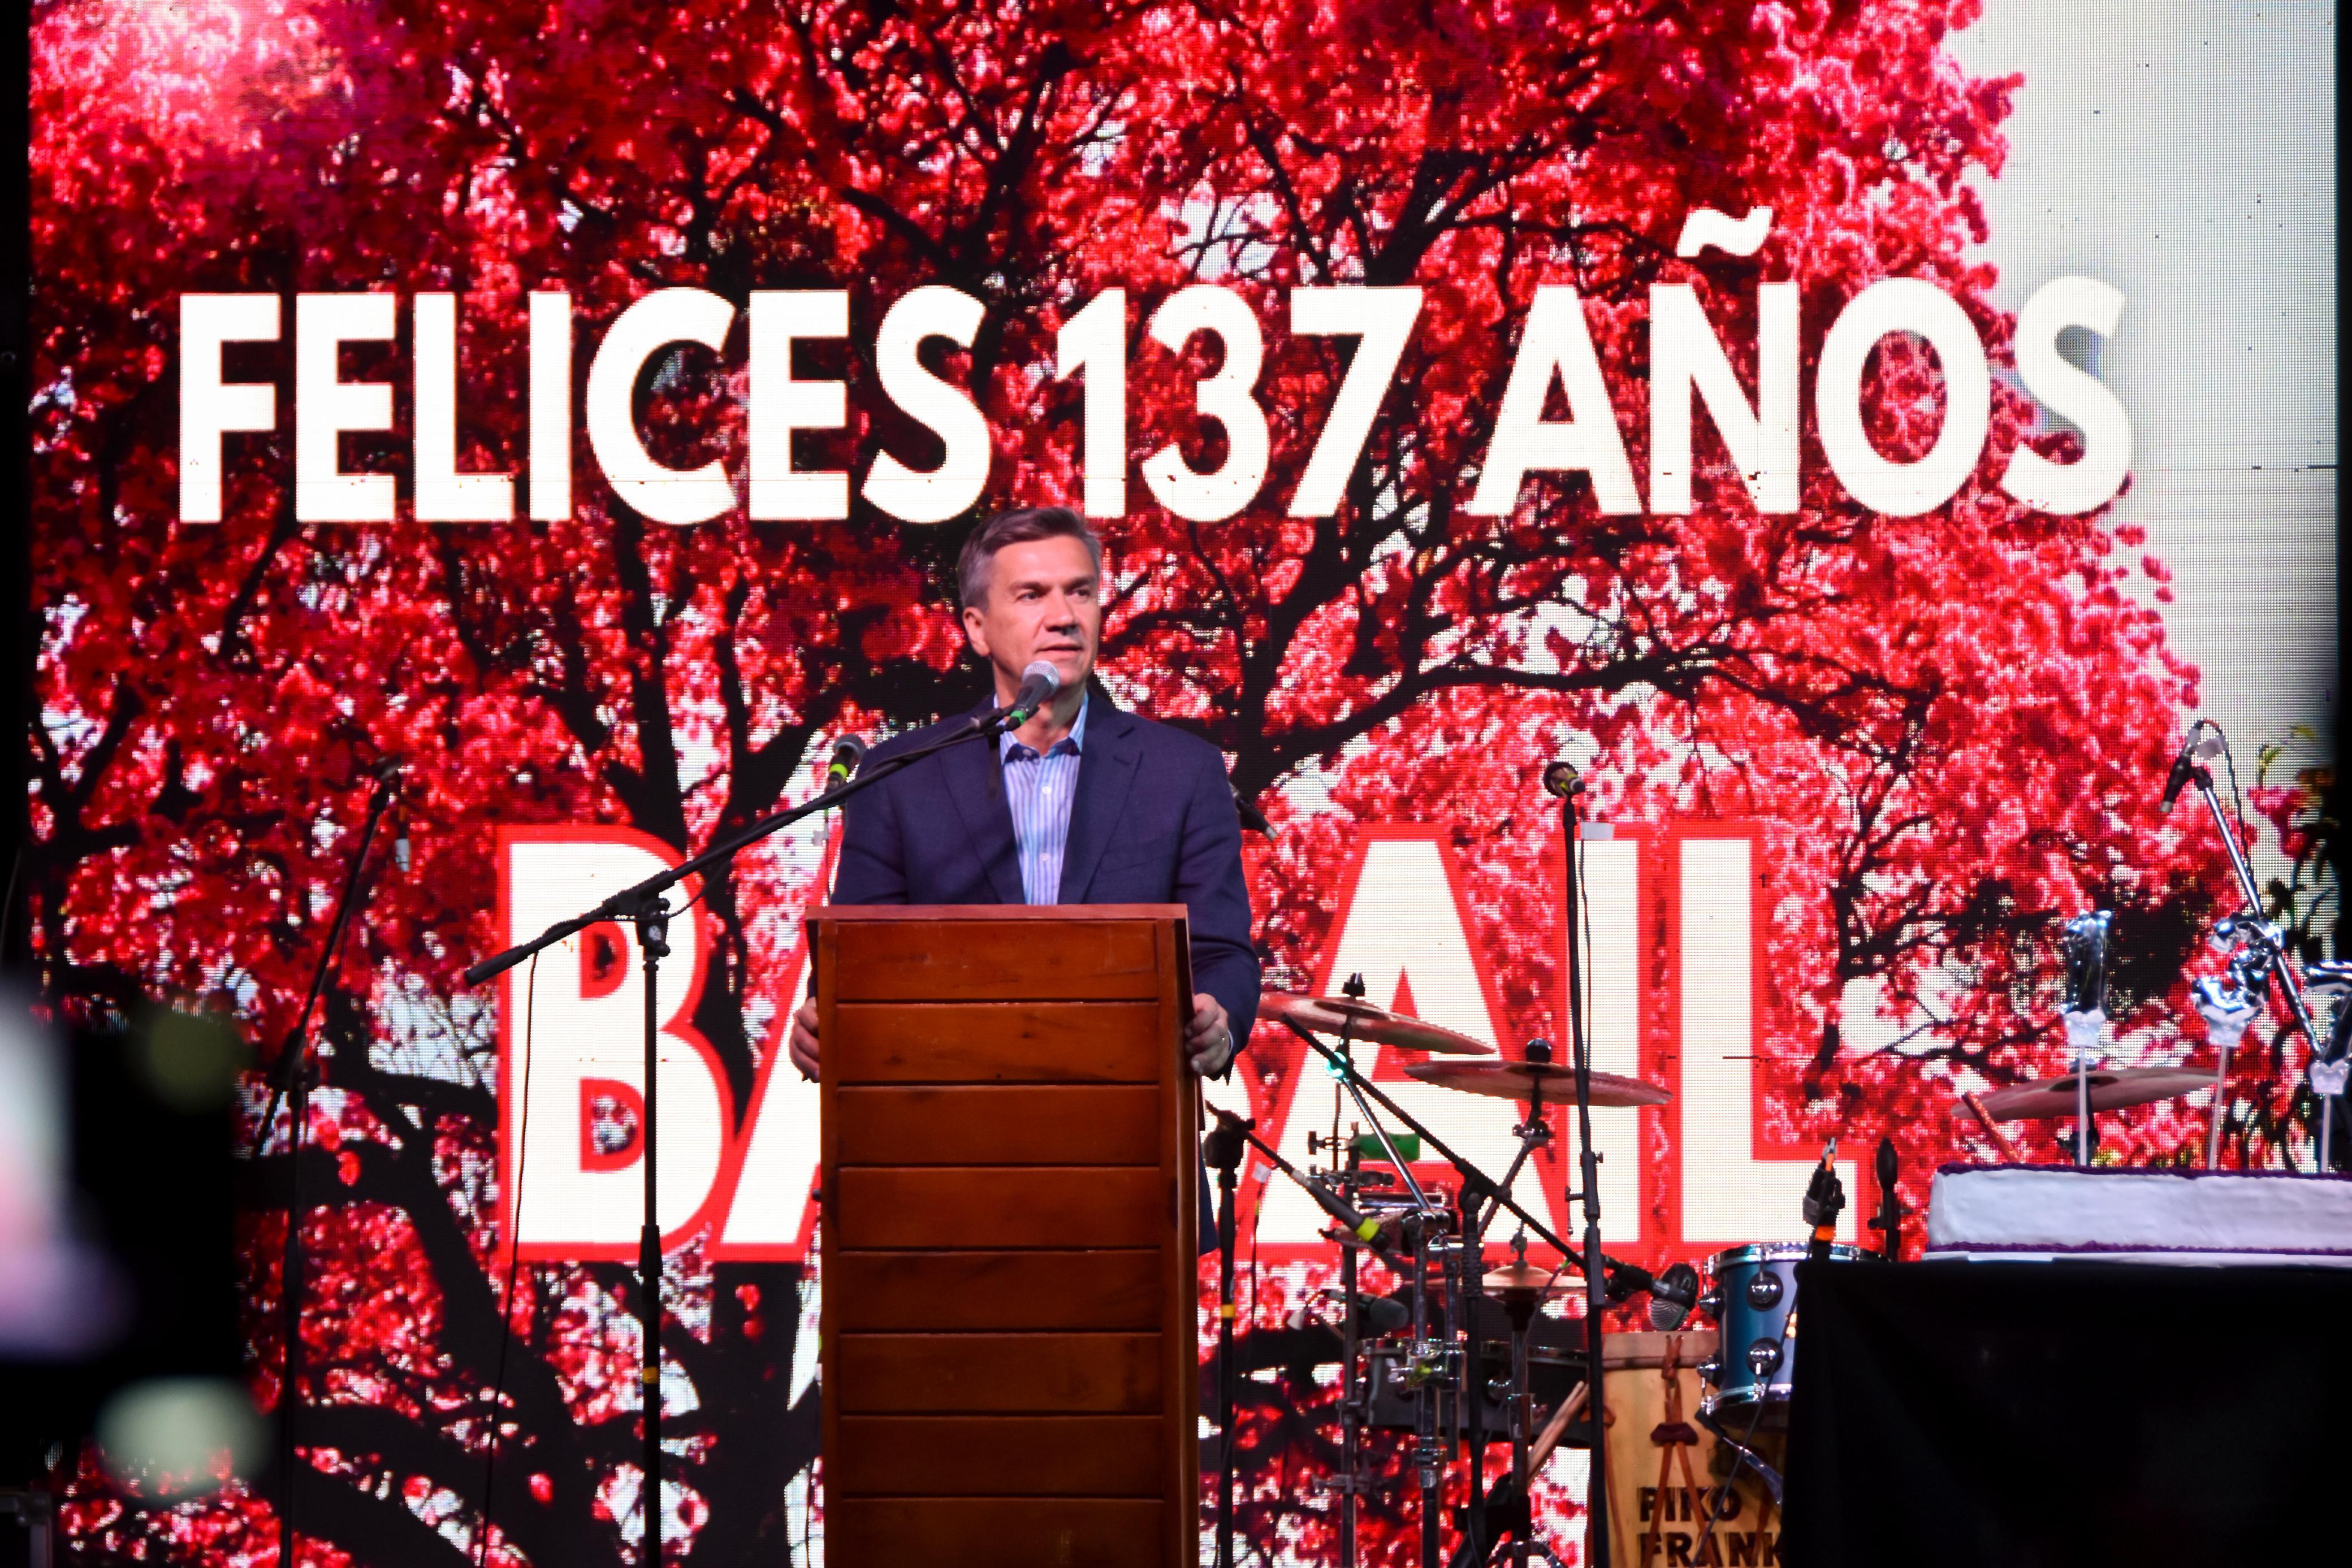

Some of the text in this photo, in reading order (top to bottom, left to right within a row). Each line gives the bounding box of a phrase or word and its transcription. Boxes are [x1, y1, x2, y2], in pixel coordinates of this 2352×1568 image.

[178, 206, 2134, 524] FELICES 137 AÑOS
[500, 828, 1859, 1256] BAIL
